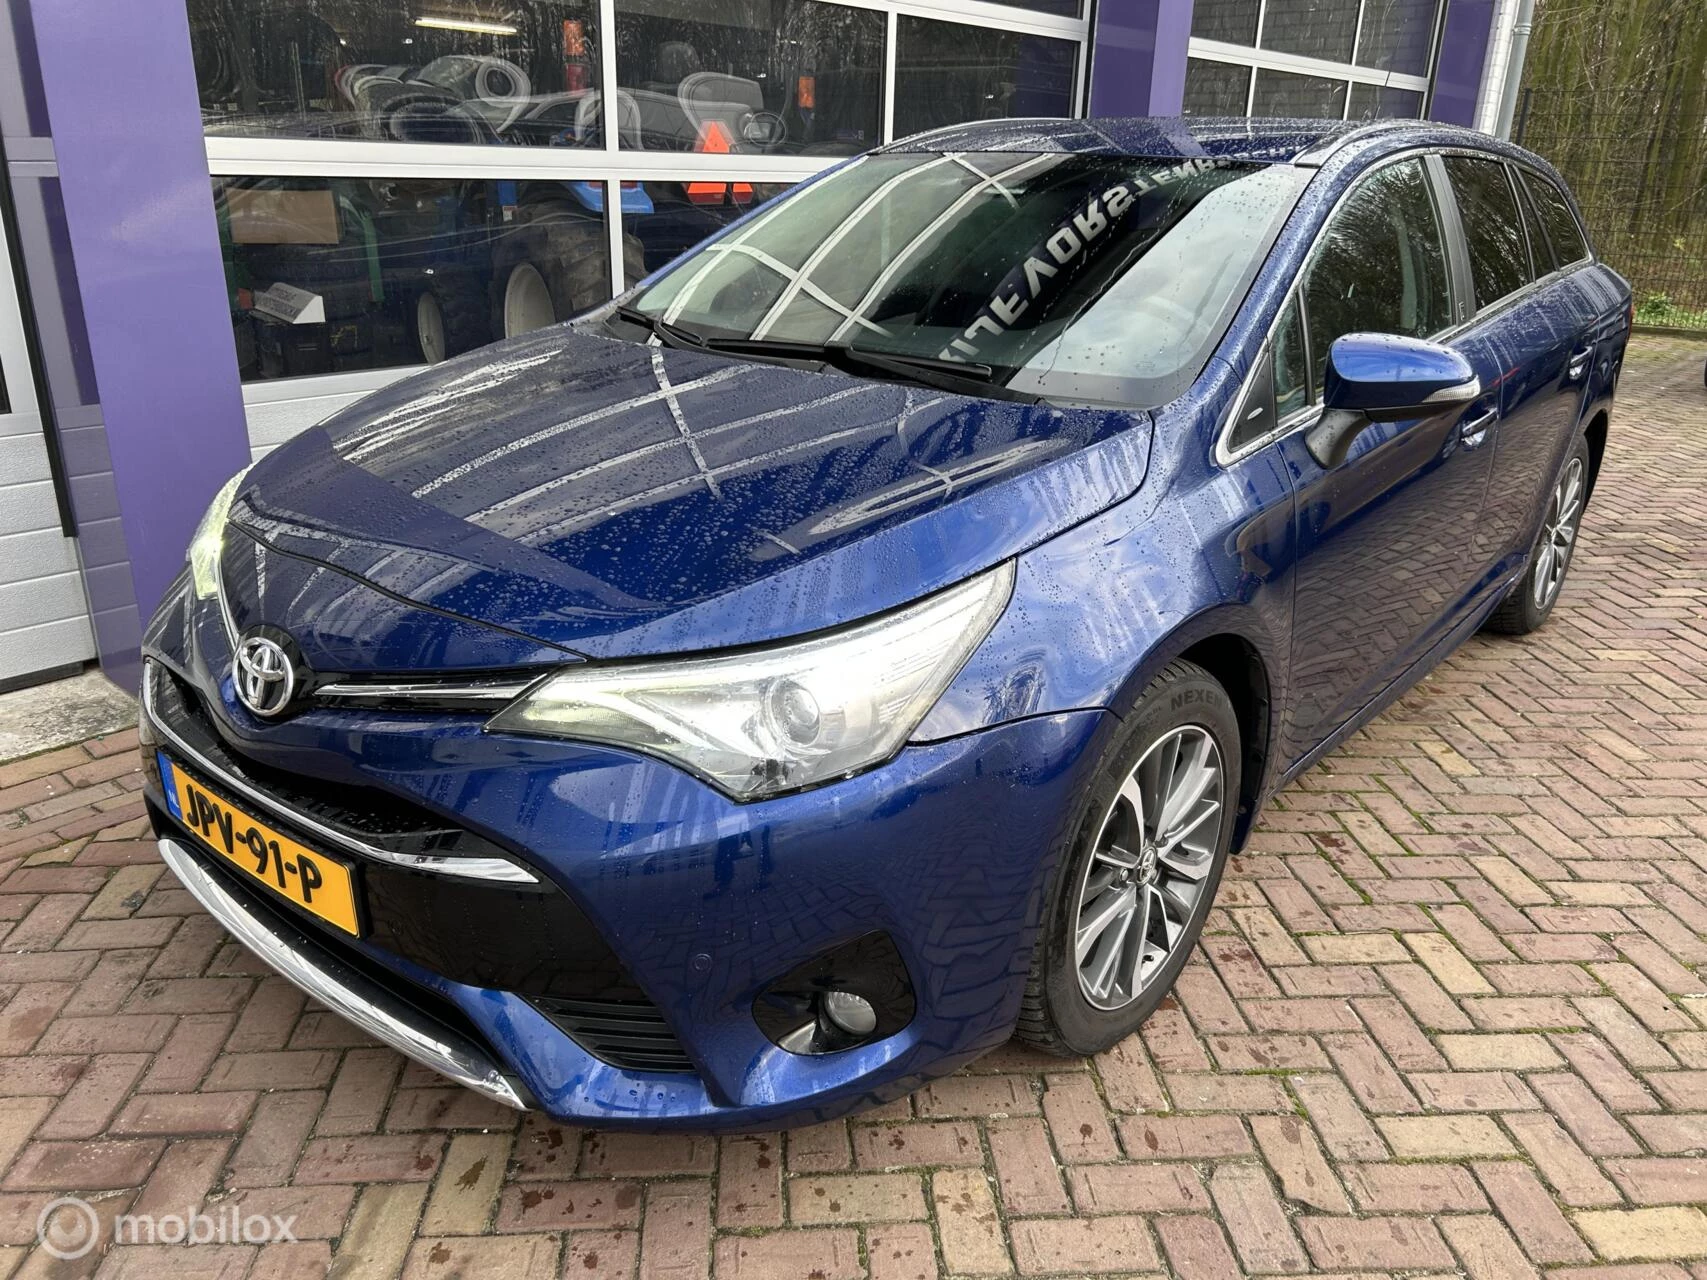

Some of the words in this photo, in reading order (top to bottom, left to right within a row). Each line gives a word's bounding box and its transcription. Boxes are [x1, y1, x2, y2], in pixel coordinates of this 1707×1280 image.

[1170, 689, 1223, 711] NEXEN
[168, 789, 180, 808] NL
[186, 784, 322, 903] JPV-91-P
